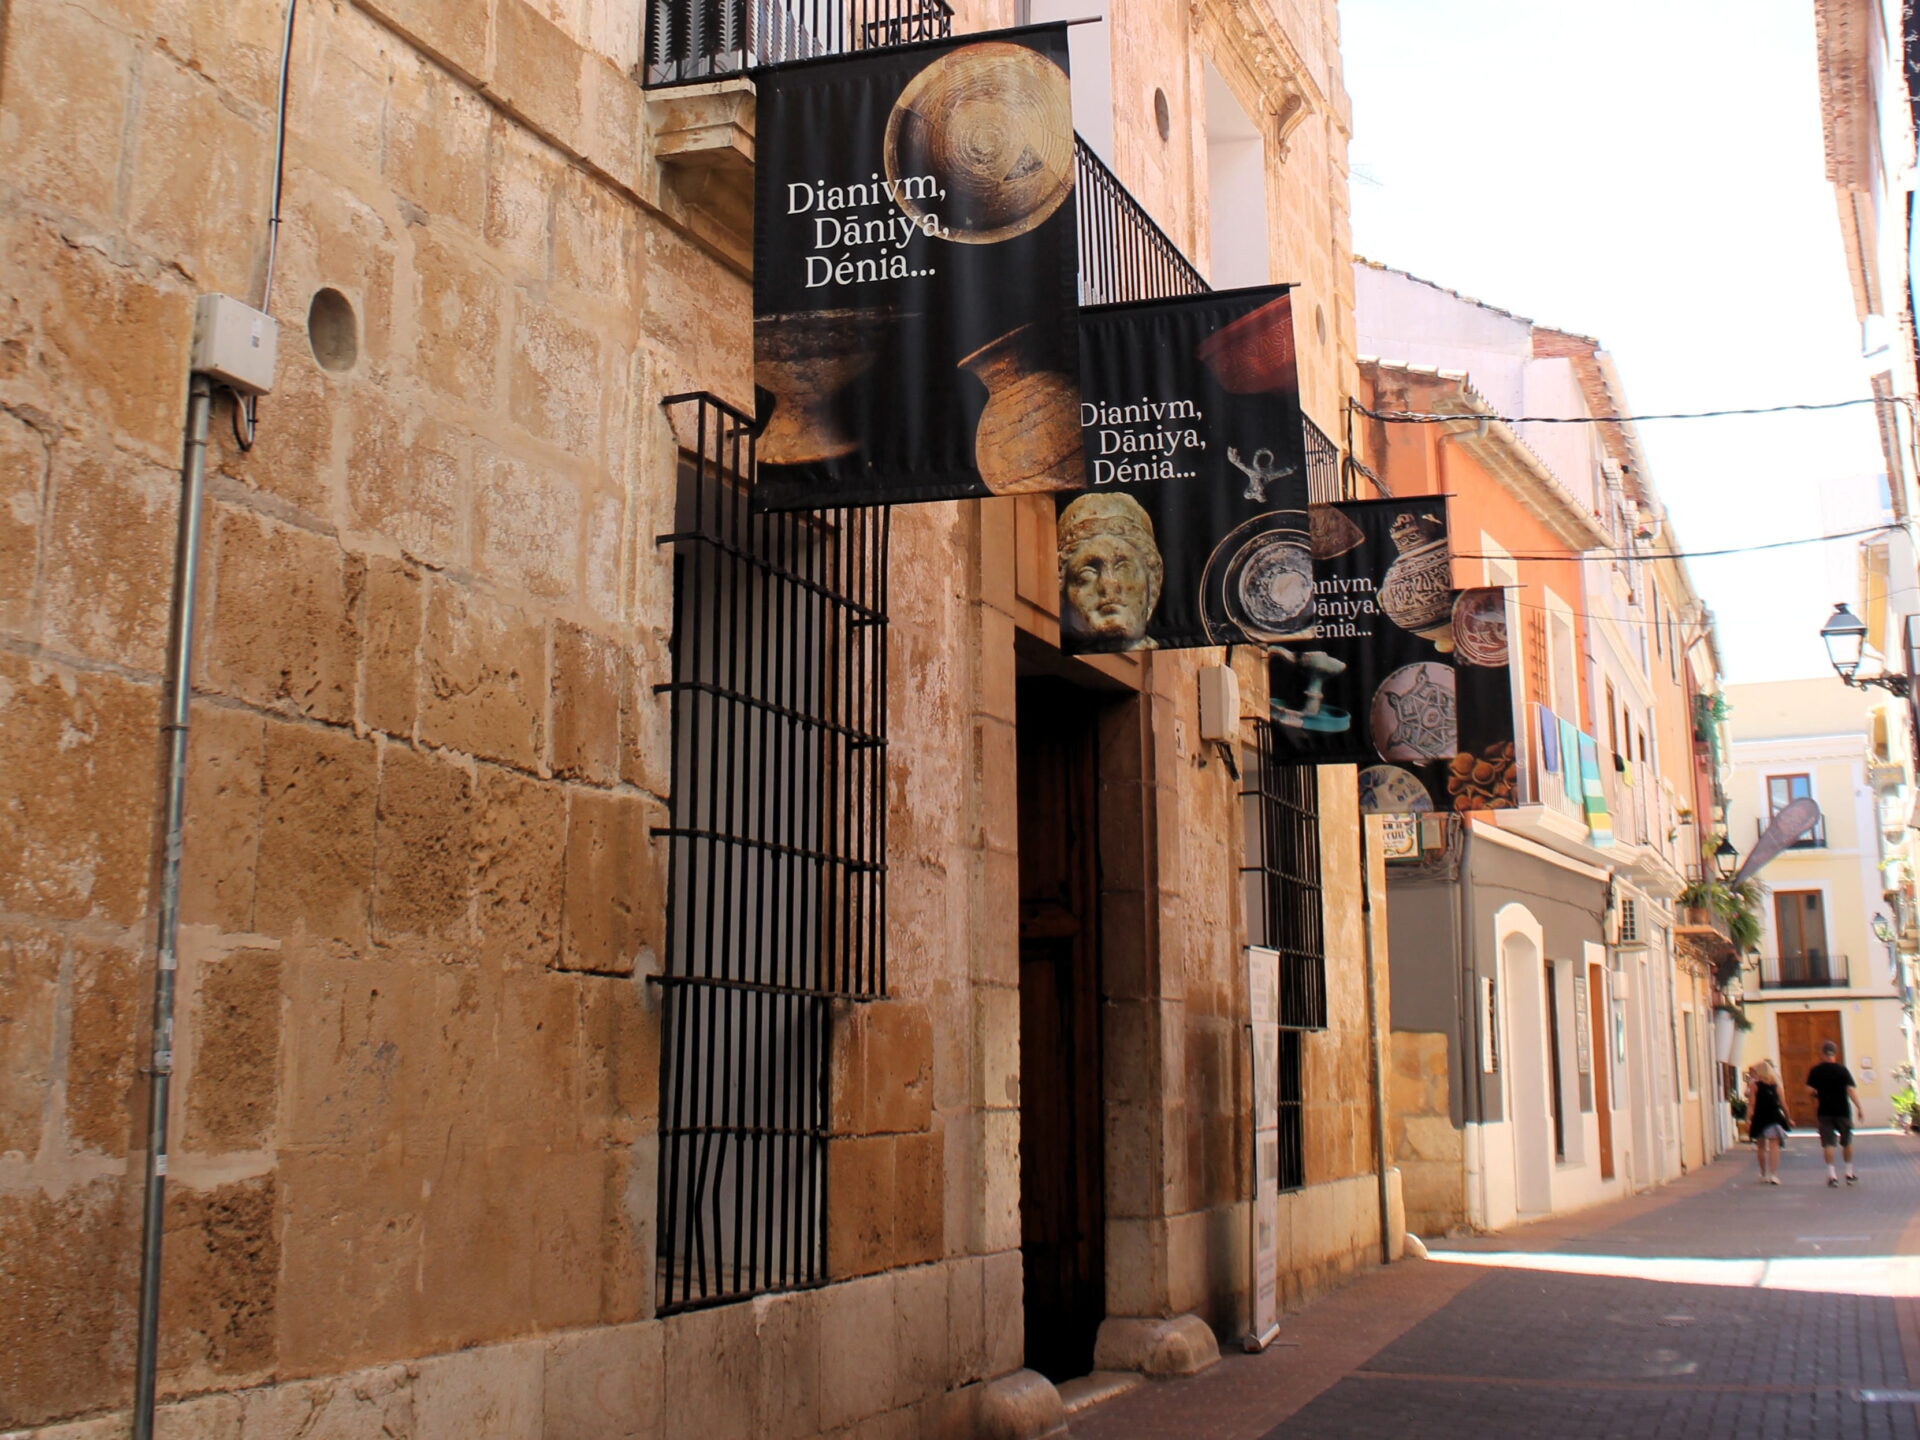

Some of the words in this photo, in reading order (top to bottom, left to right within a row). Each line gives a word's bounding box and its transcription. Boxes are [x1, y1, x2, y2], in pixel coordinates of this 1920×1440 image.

[787, 173, 947, 215] Dianivm,
[814, 208, 949, 249] Dāniya,
[805, 248, 936, 288] Dénia...
[1081, 397, 1202, 427] Dianivm,
[1099, 425, 1206, 456] Dāniya,
[1093, 458, 1196, 485] Dénia...
[1313, 574, 1378, 595] anivm,
[1313, 596, 1380, 620] āniya,
[1315, 618, 1372, 638] énia...
